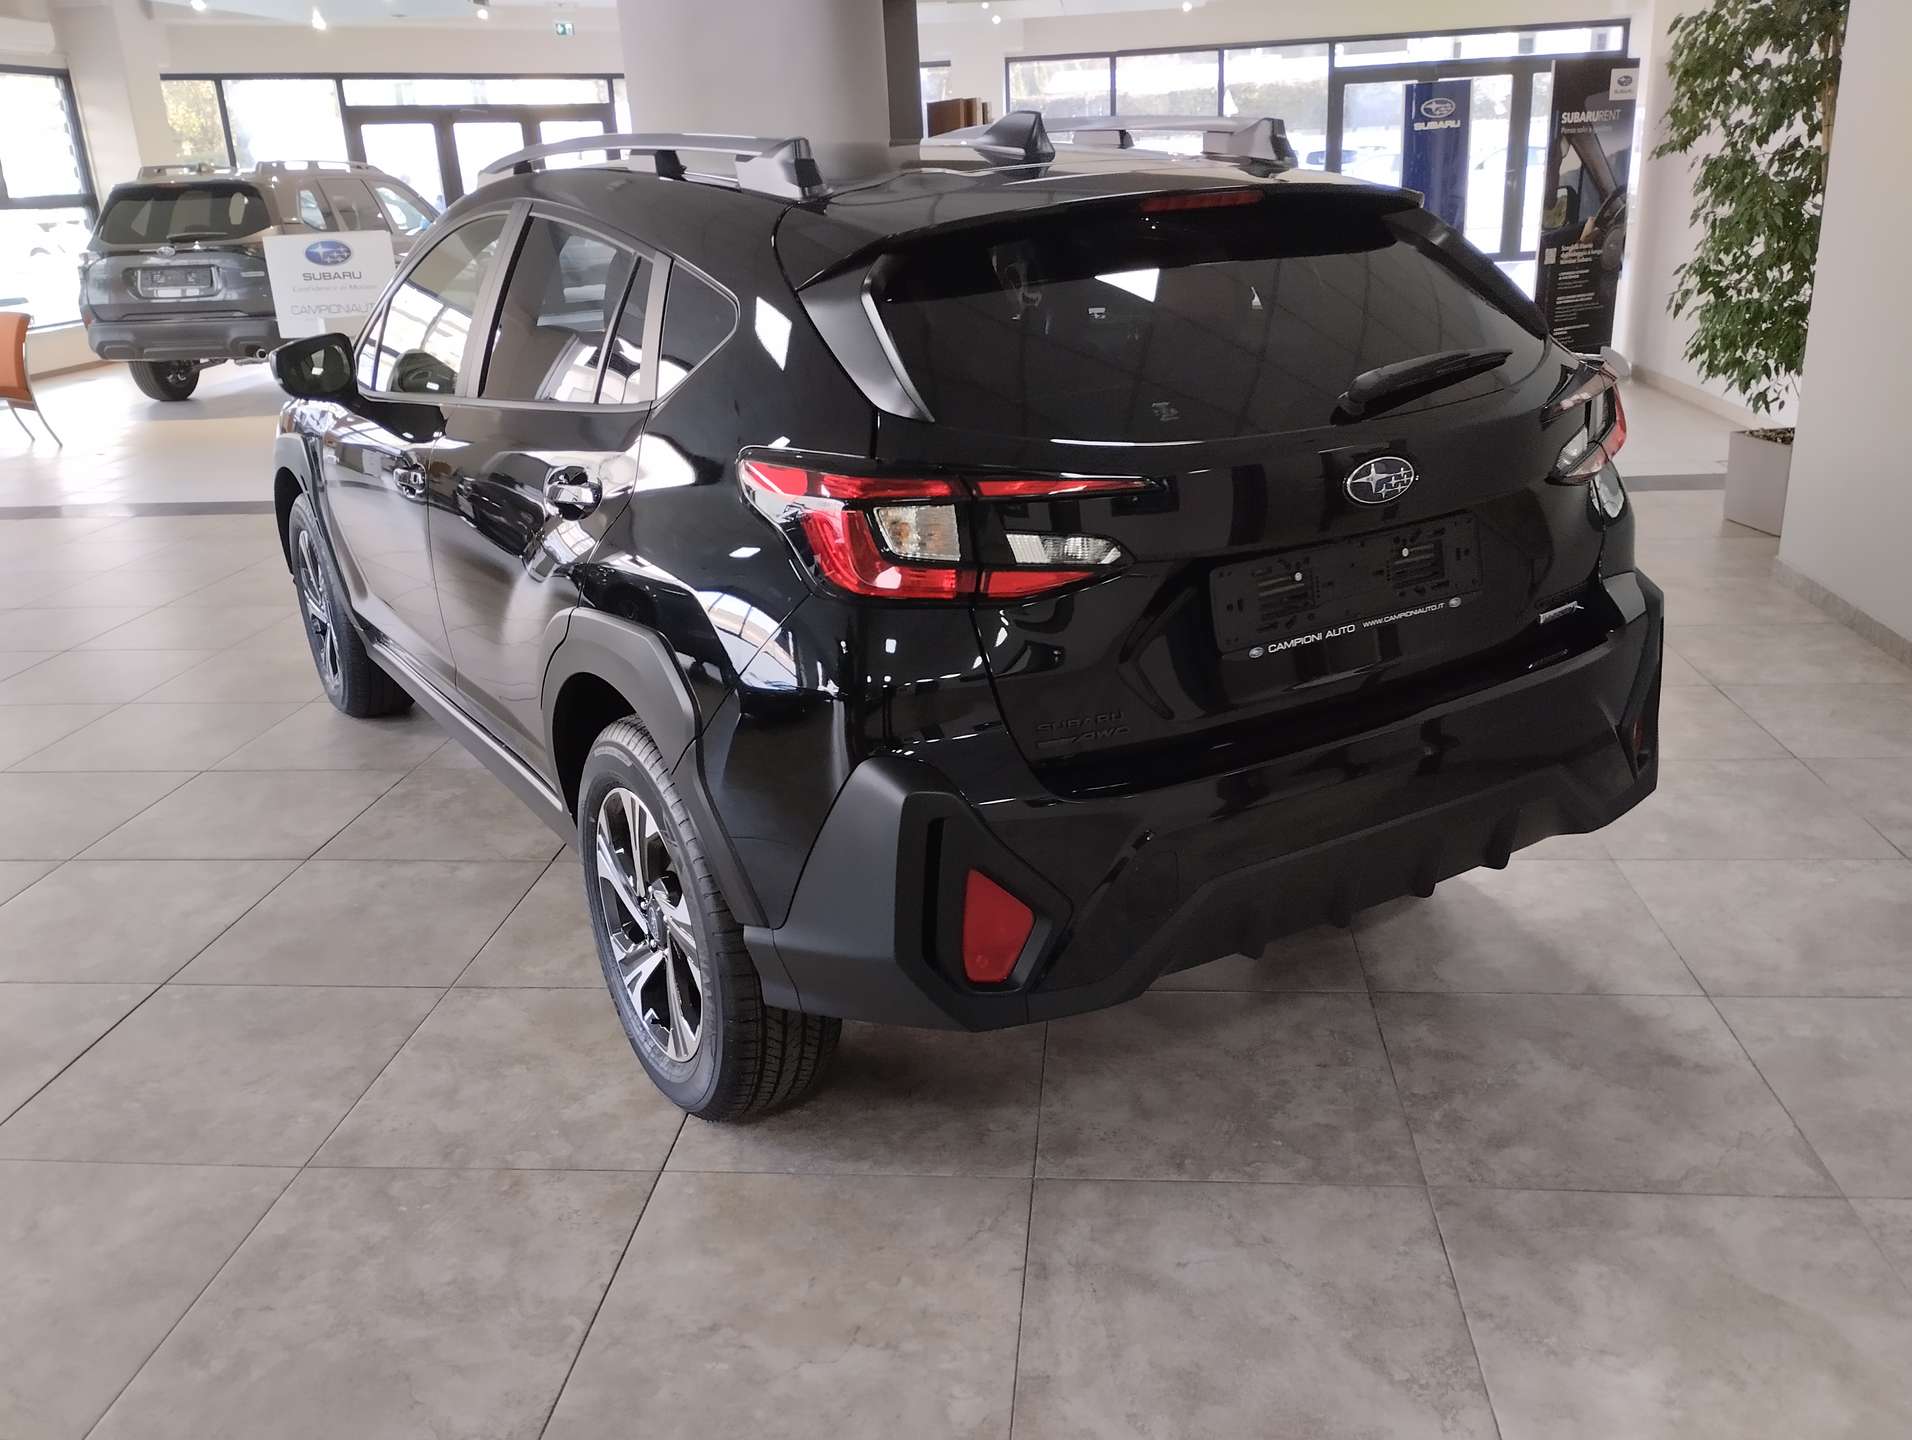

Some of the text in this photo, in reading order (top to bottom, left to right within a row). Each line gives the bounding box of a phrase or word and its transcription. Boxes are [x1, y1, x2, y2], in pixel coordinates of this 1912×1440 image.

[1413, 119, 1461, 131] SUBARU
[302, 271, 362, 281] SUBARU
[1267, 632, 1323, 653] CAMPIONI
[1325, 624, 1356, 639] AUTO
